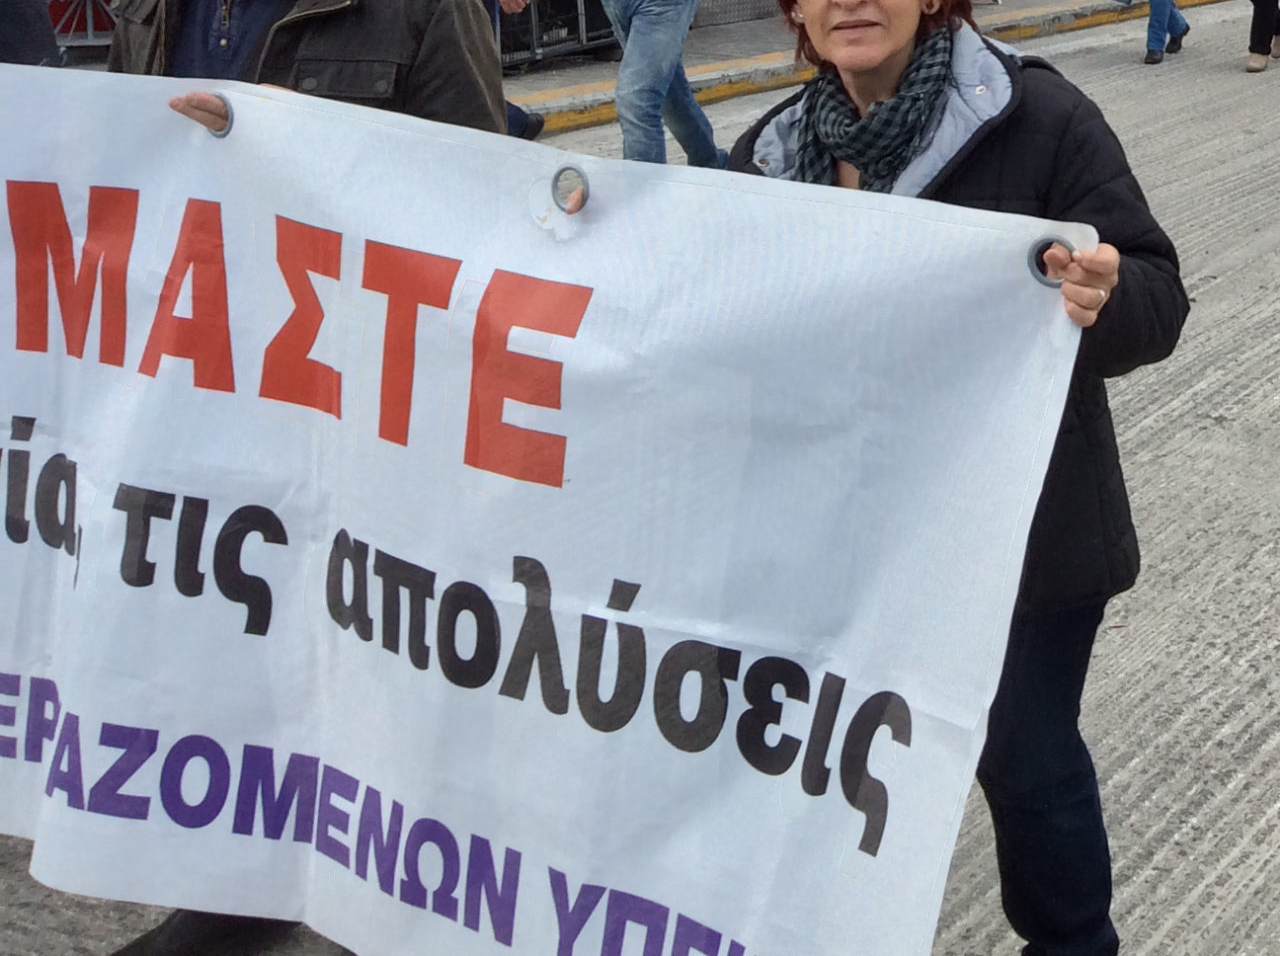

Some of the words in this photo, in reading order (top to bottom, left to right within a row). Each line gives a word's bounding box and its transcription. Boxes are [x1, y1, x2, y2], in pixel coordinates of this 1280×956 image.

[6, 180, 594, 488] ΜΑΣΤΕ
[112, 482, 289, 637] τις
[325, 528, 912, 857] απολύσεις
